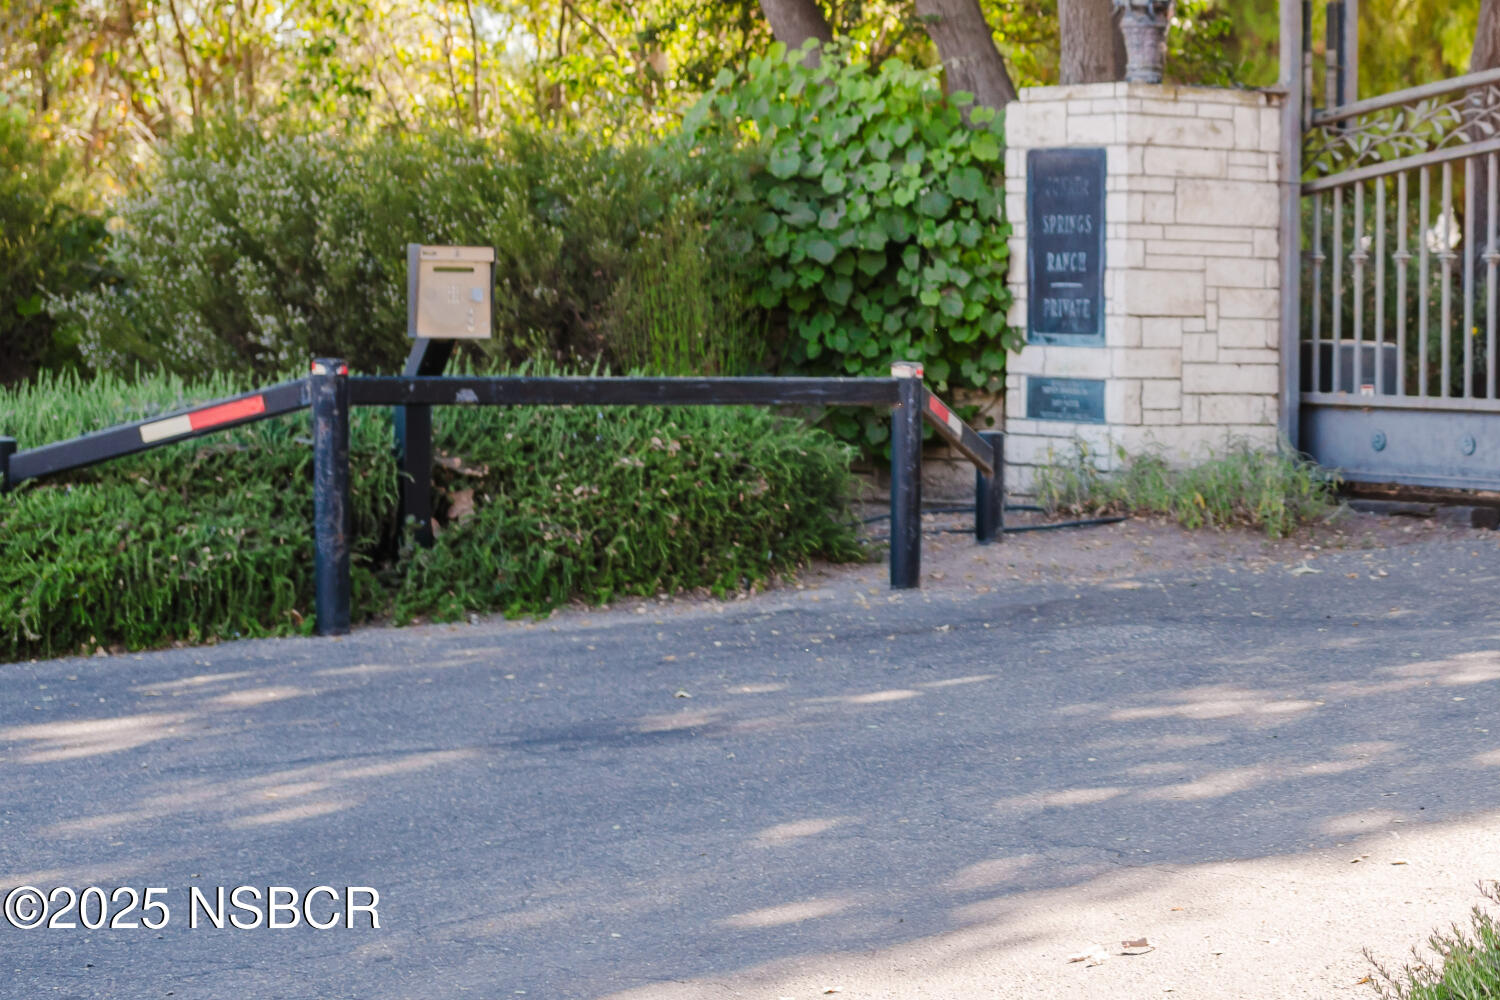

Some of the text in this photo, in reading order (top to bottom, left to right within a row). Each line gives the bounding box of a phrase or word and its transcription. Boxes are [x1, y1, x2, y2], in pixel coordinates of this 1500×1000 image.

[1042, 213, 1092, 235] SPRINGS
[1046, 251, 1087, 273] RANCH
[1042, 297, 1091, 319] PRIVATE
